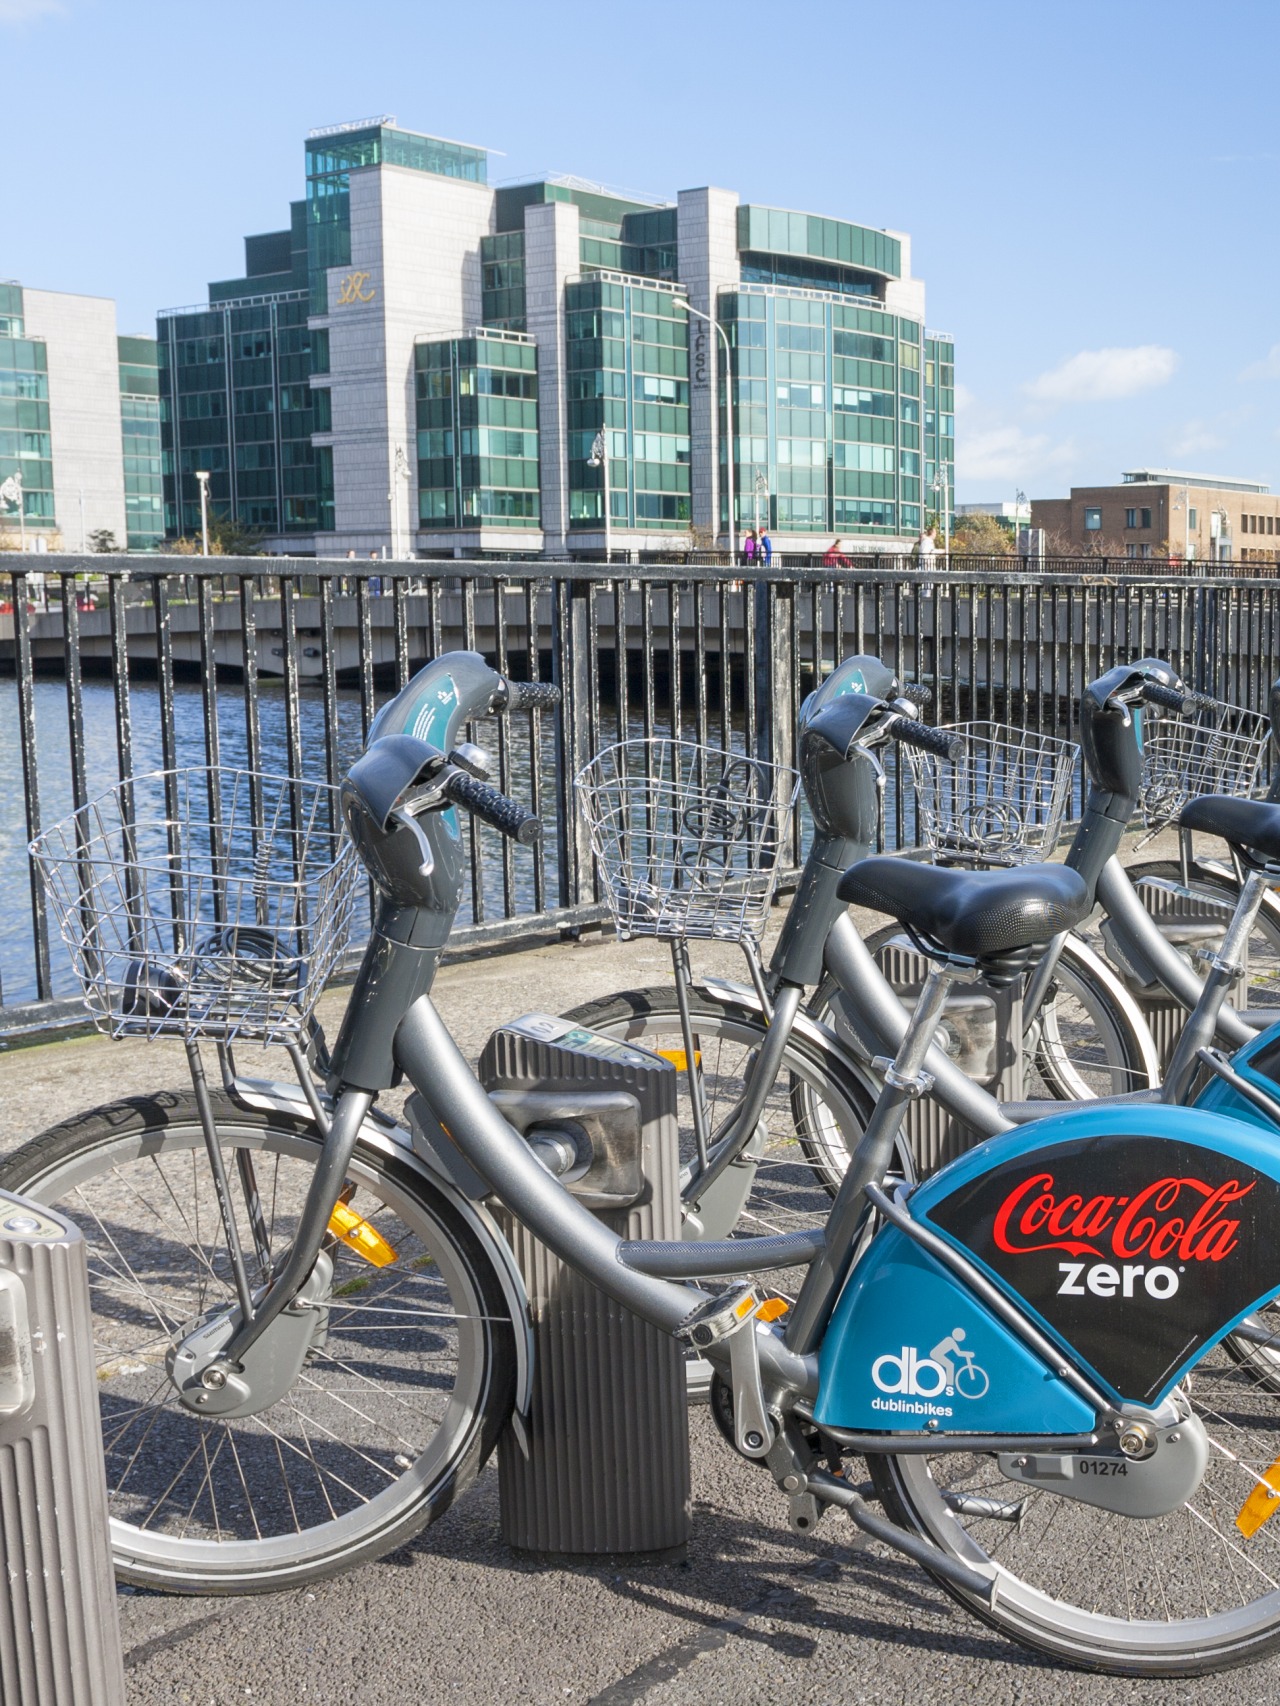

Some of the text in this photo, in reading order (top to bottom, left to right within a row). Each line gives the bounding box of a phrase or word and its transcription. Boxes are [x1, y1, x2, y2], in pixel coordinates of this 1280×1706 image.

[993, 1173, 1256, 1262] Coca-Cola
[1057, 1262, 1180, 1300] zero
[871, 1397, 954, 1417] dublinbikes
[1079, 1460, 1129, 1477] 01274
